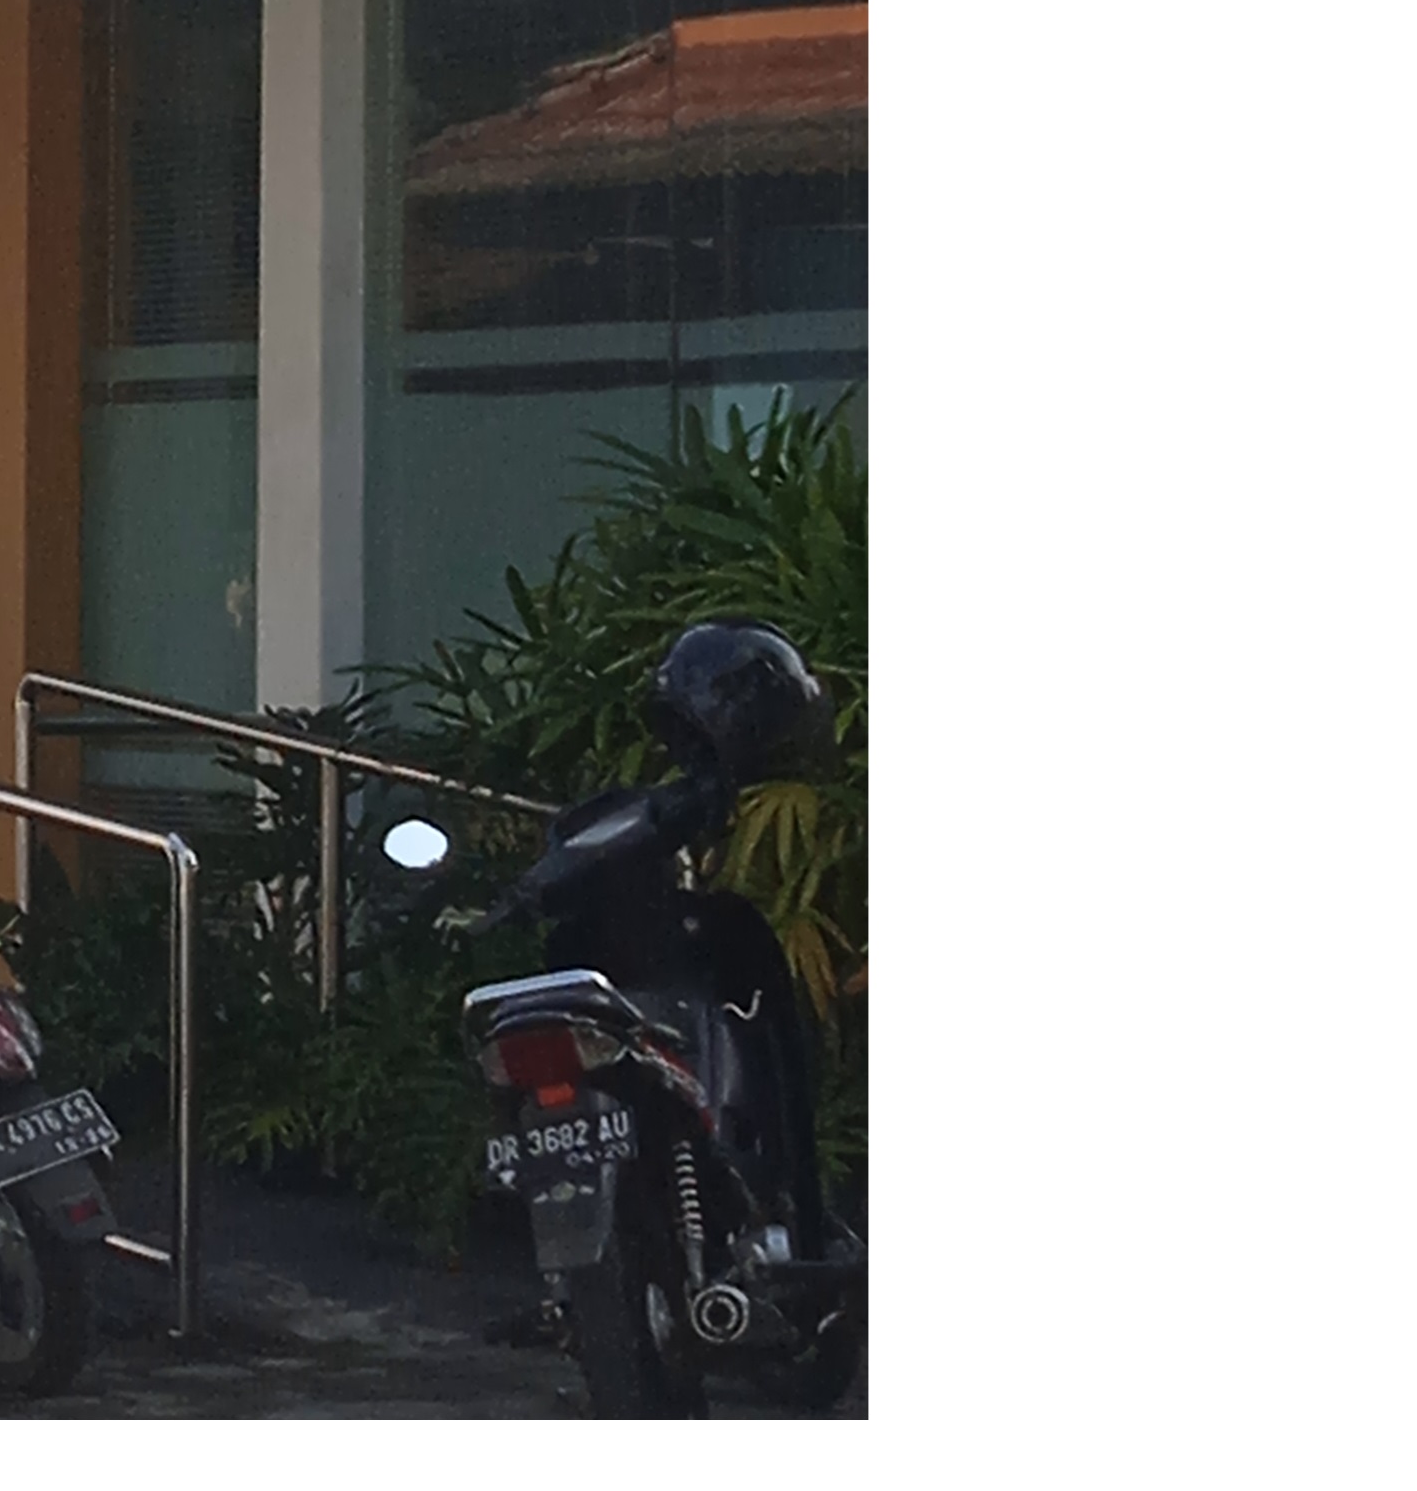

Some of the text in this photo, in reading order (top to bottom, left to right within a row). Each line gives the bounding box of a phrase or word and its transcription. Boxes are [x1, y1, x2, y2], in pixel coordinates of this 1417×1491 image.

[60, 1095, 96, 1126] CS
[486, 1110, 630, 1169] DR 3682 AU
